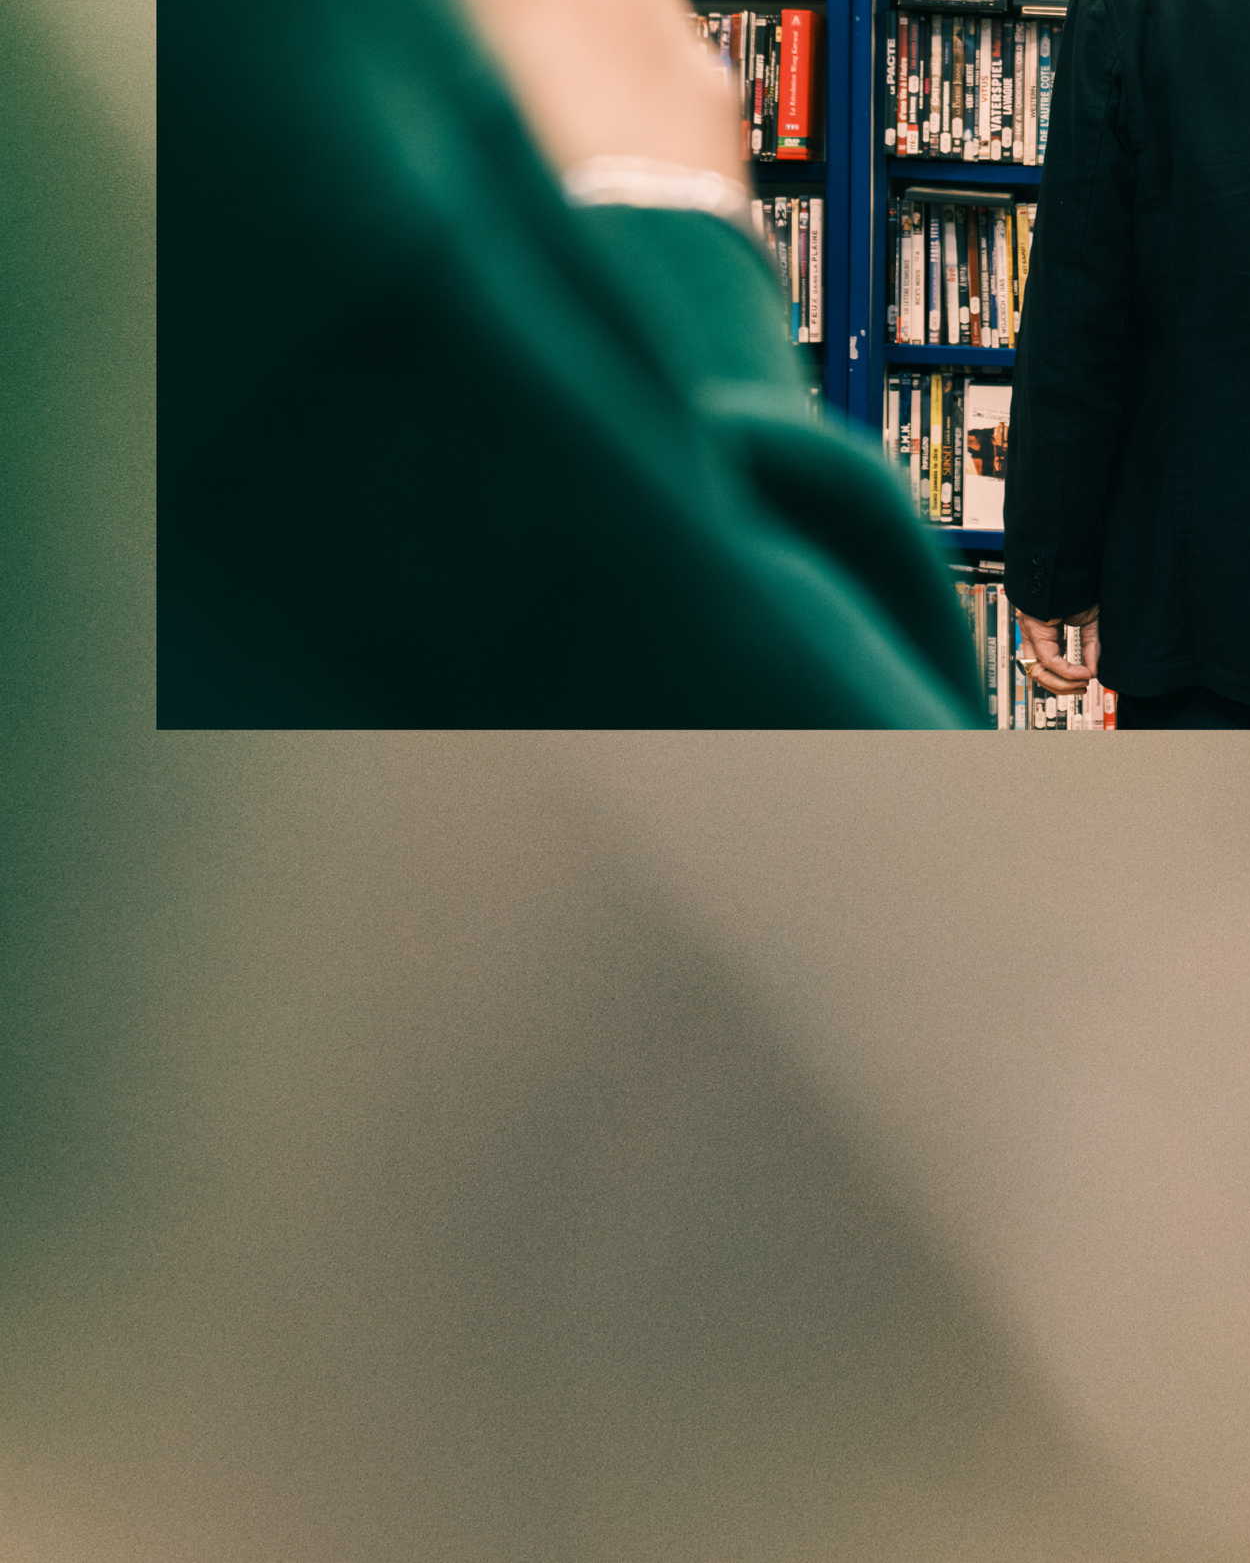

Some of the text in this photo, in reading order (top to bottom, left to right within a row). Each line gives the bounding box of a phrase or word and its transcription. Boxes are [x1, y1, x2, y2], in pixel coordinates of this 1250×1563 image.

[887, 39, 895, 84] PACTE
[981, 76, 989, 103] VITUS
[991, 59, 1002, 131] VATERSPIEL
[914, 269, 922, 305] NICK'S MOVIE
[998, 278, 1007, 292] HAS
[998, 304, 1007, 334] WOJCIECH
[901, 423, 910, 453] R.M.N.
[931, 449, 939, 460] dire
[942, 445, 951, 475] SUNSET
[931, 472, 939, 491] jamais
[931, 494, 939, 510] Sans
